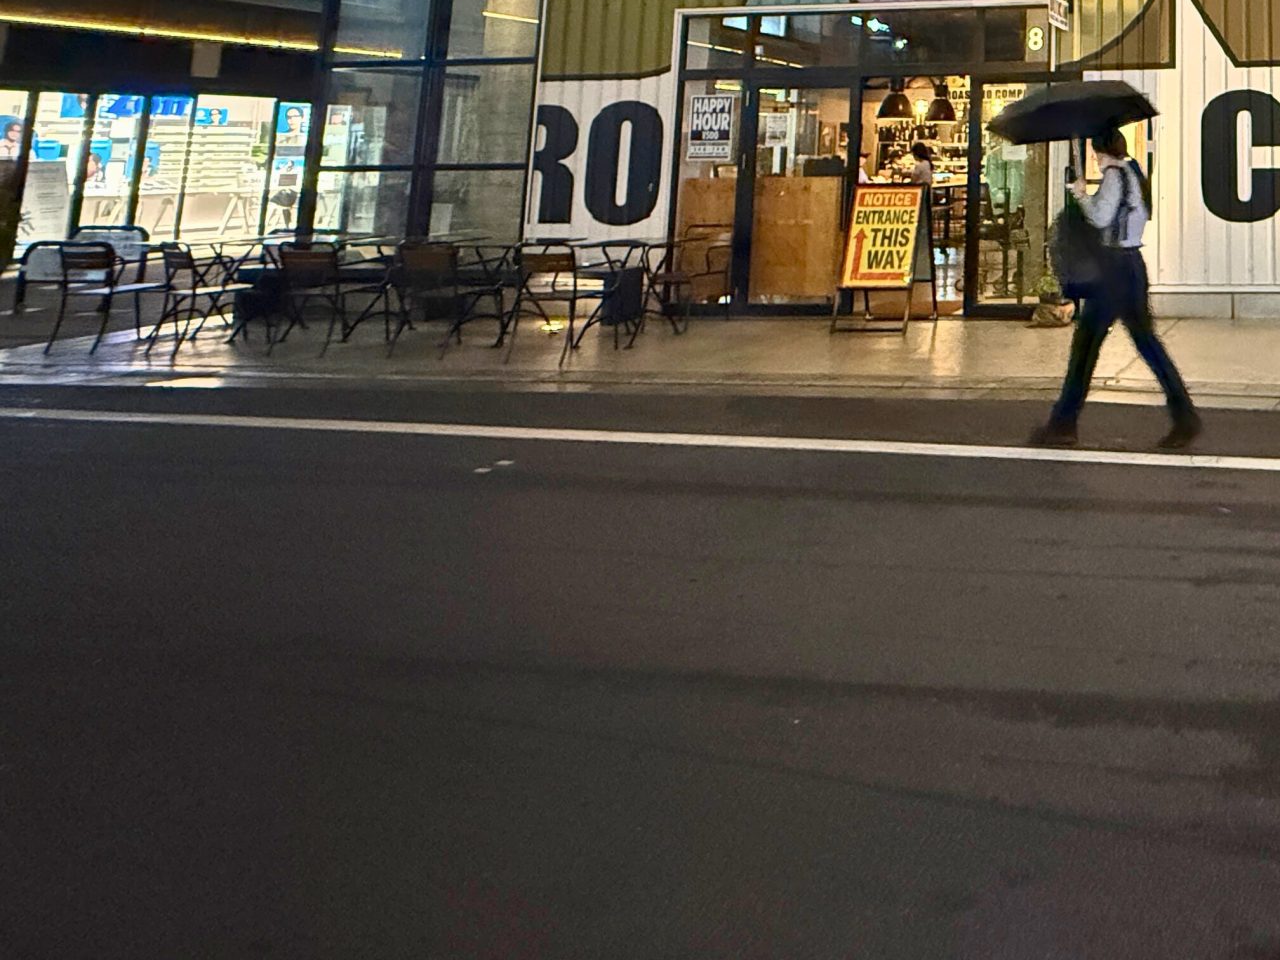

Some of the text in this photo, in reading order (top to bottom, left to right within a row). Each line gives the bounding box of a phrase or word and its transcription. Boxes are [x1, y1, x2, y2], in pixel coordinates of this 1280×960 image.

[1028, 26, 1044, 51] 8
[694, 98, 731, 113] HAPPY
[692, 113, 729, 131] HOUR
[863, 193, 912, 206] NOTICE
[855, 209, 915, 225] ENTRANCE
[870, 227, 911, 248] THIS
[866, 249, 907, 270] WAY
